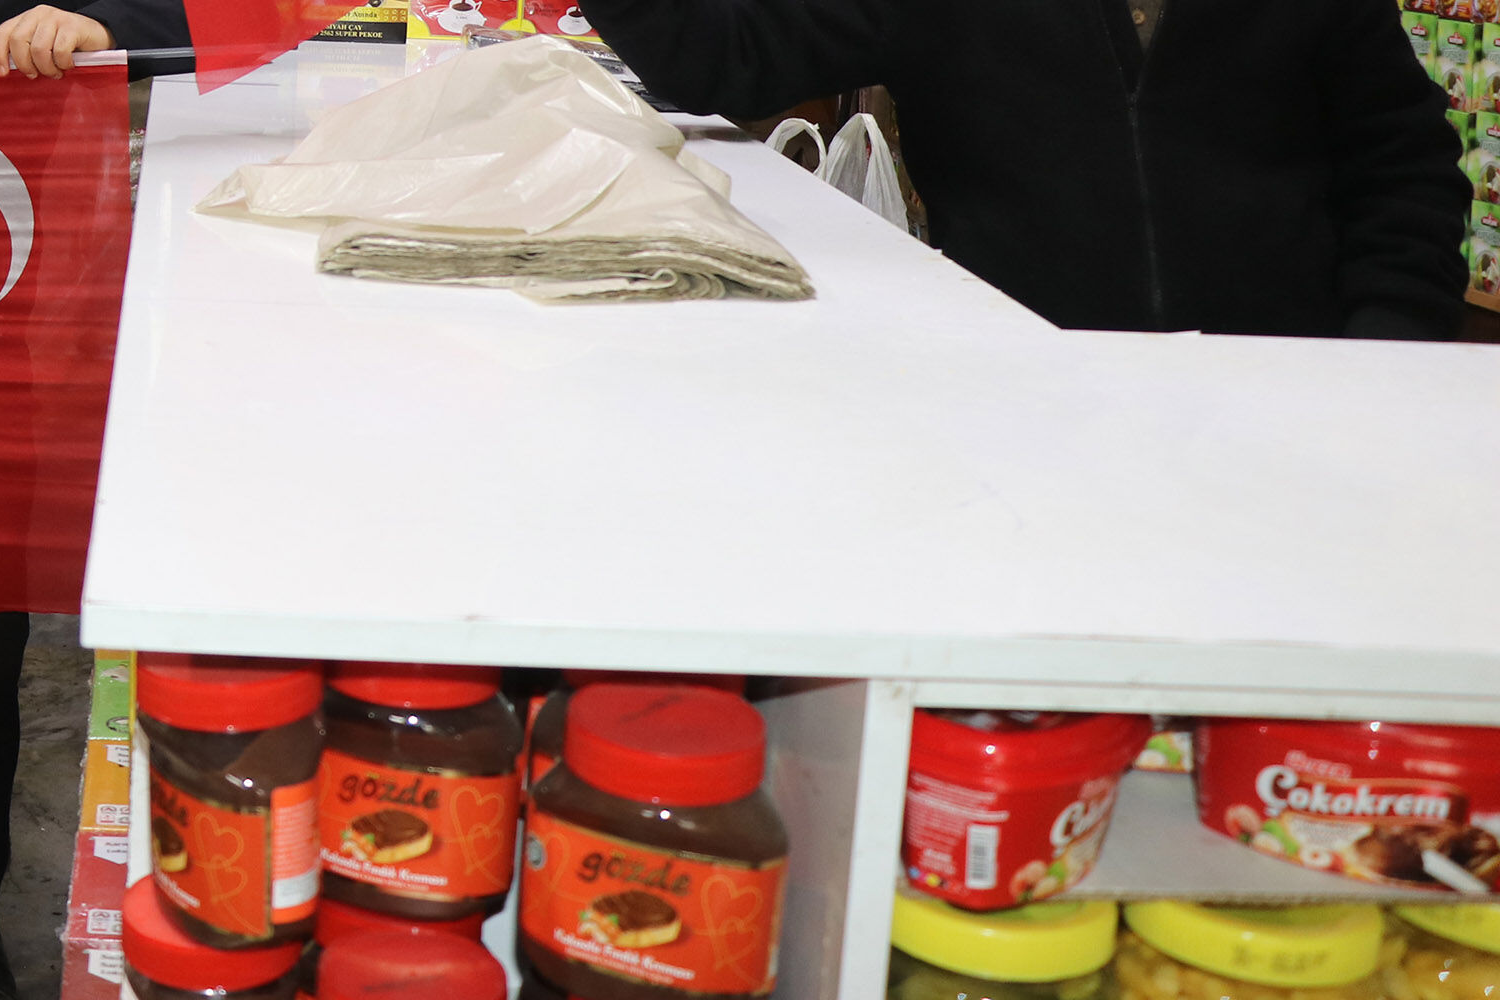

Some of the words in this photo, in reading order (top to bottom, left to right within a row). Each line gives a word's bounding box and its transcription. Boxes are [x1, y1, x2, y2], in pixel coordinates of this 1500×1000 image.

[339, 772, 440, 809] gözde
[1255, 764, 1451, 819] Çokokrem
[577, 851, 691, 896] gözde
